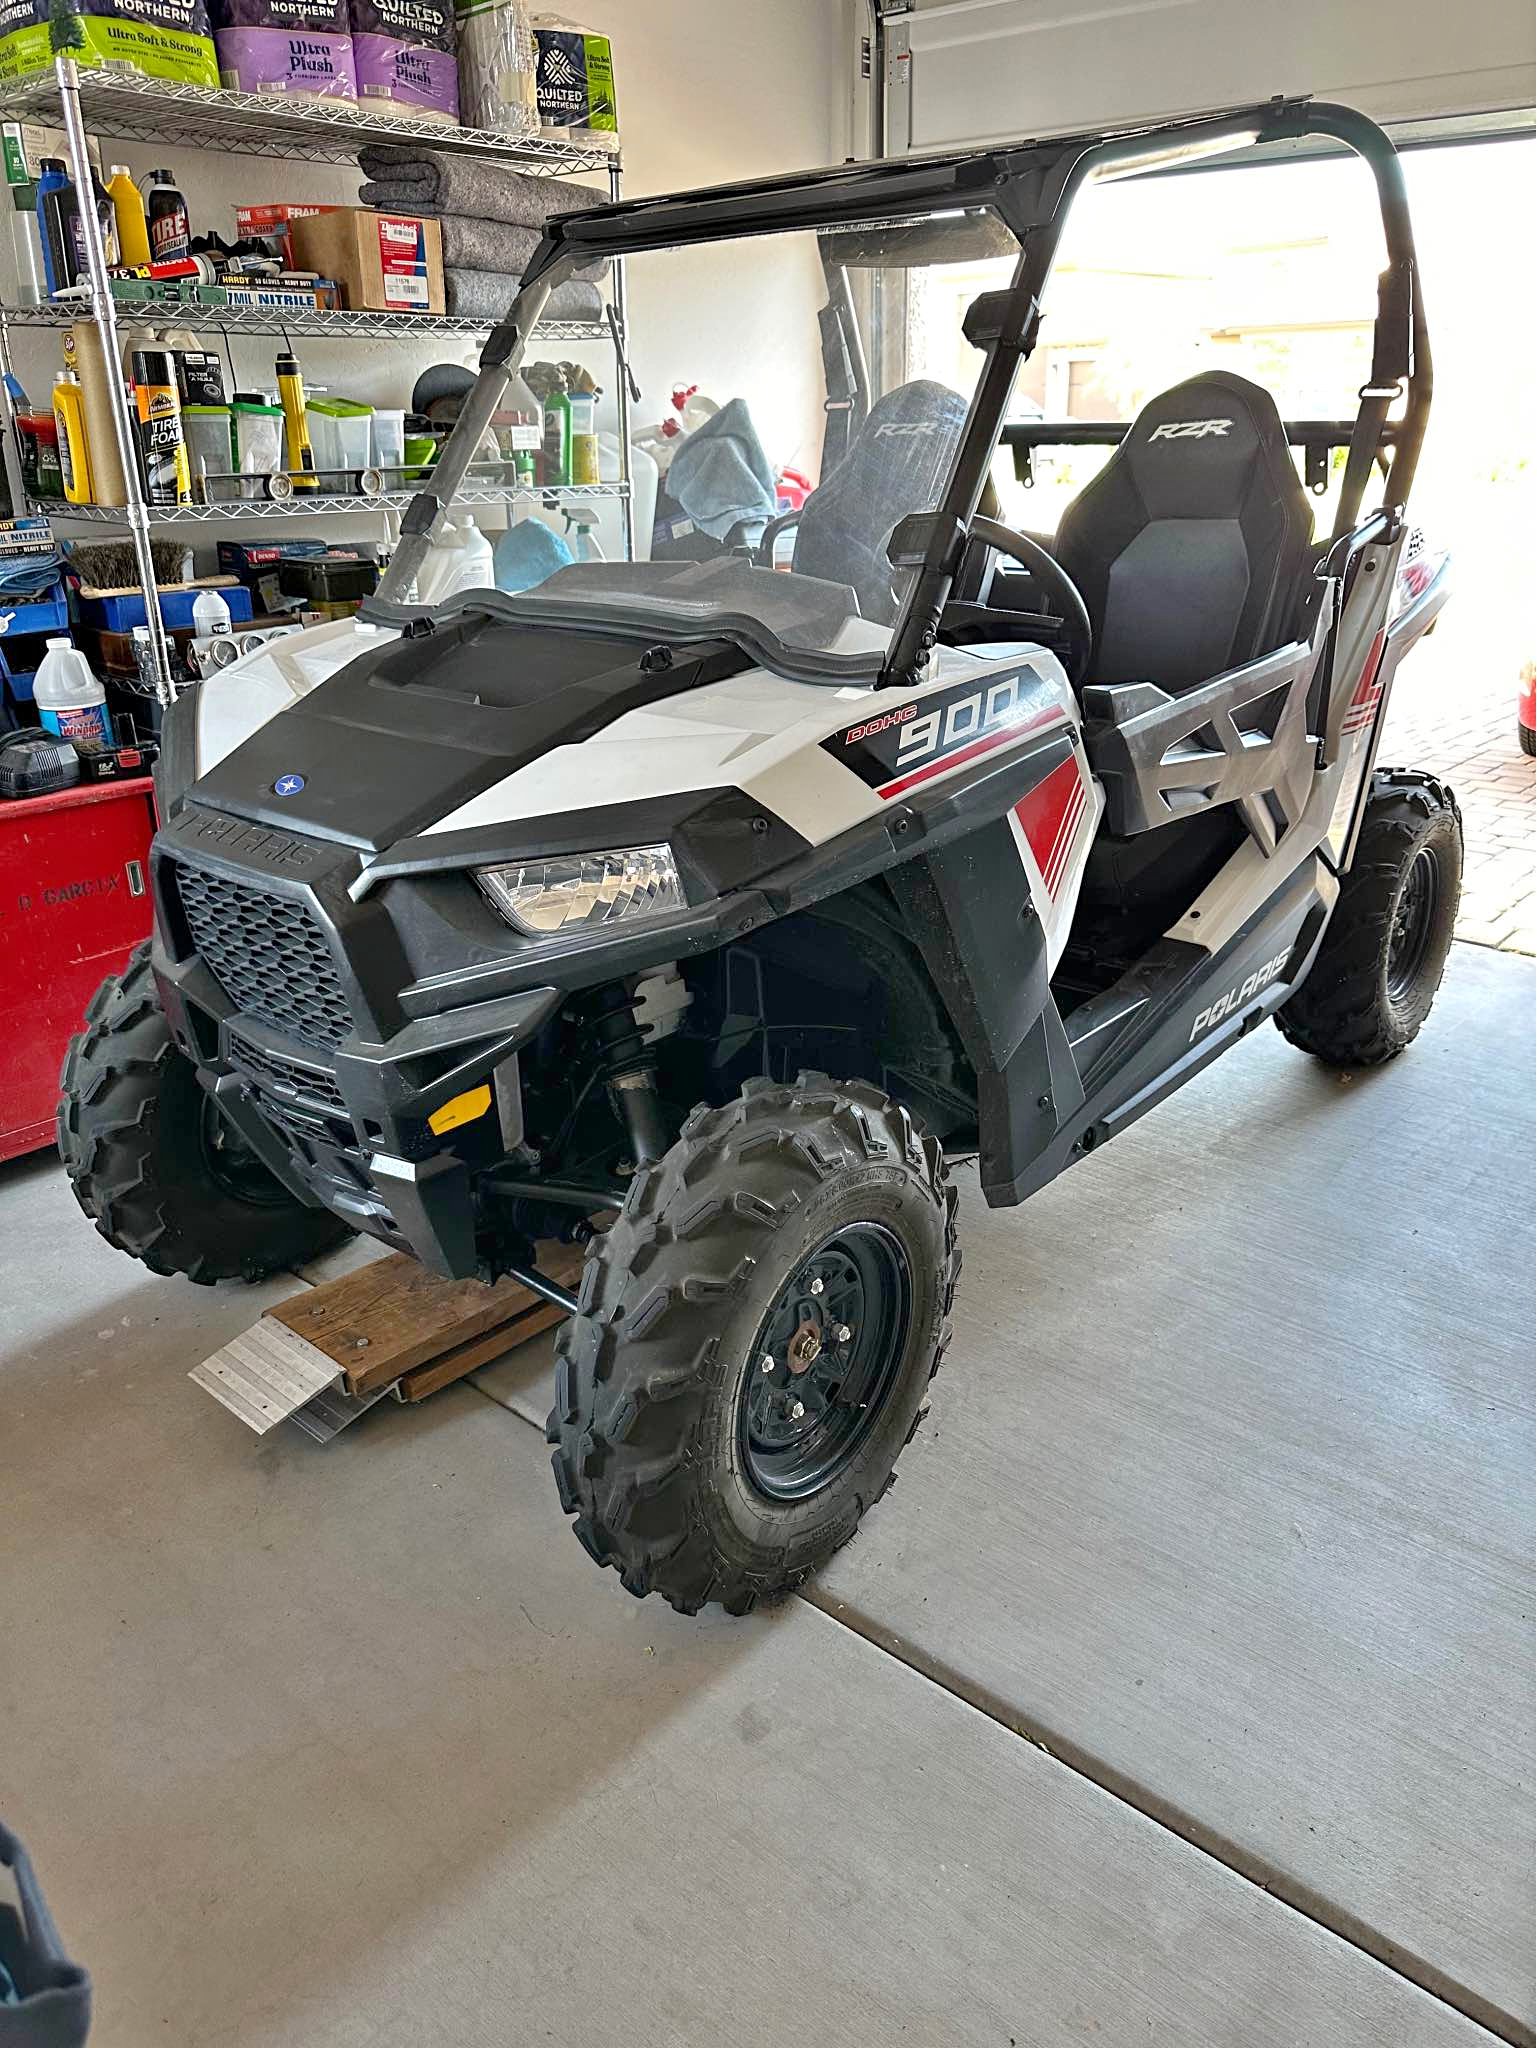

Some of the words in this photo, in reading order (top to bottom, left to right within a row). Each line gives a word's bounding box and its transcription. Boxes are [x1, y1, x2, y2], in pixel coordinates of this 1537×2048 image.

[114, 0, 190, 22] NORTHERN
[270, 1, 335, 17] NORTHERN
[382, 11, 438, 35] NORTHERN
[108, 27, 136, 41] Ultra
[137, 32, 159, 46] Soft
[169, 40, 203, 57] Strong
[289, 41, 331, 56] Ultra
[289, 56, 334, 73] Plush
[391, 78, 397, 88] 3
[537, 87, 583, 102] QUILTED
[540, 99, 580, 110] NORTHERN
[287, 207, 320, 219] FRAM
[152, 215, 186, 245] TIRE
[222, 275, 250, 285] HARDY
[235, 293, 253, 305] MIL
[258, 294, 314, 306] NITRILE
[152, 417, 180, 433] TIRE
[873, 422, 938, 439] RZR
[1147, 418, 1235, 443] RZR
[11, 531, 51, 540] NITRILE
[846, 704, 918, 746] DOHC
[896, 676, 1020, 768] 900
[1188, 943, 1294, 1043] POLARIS
